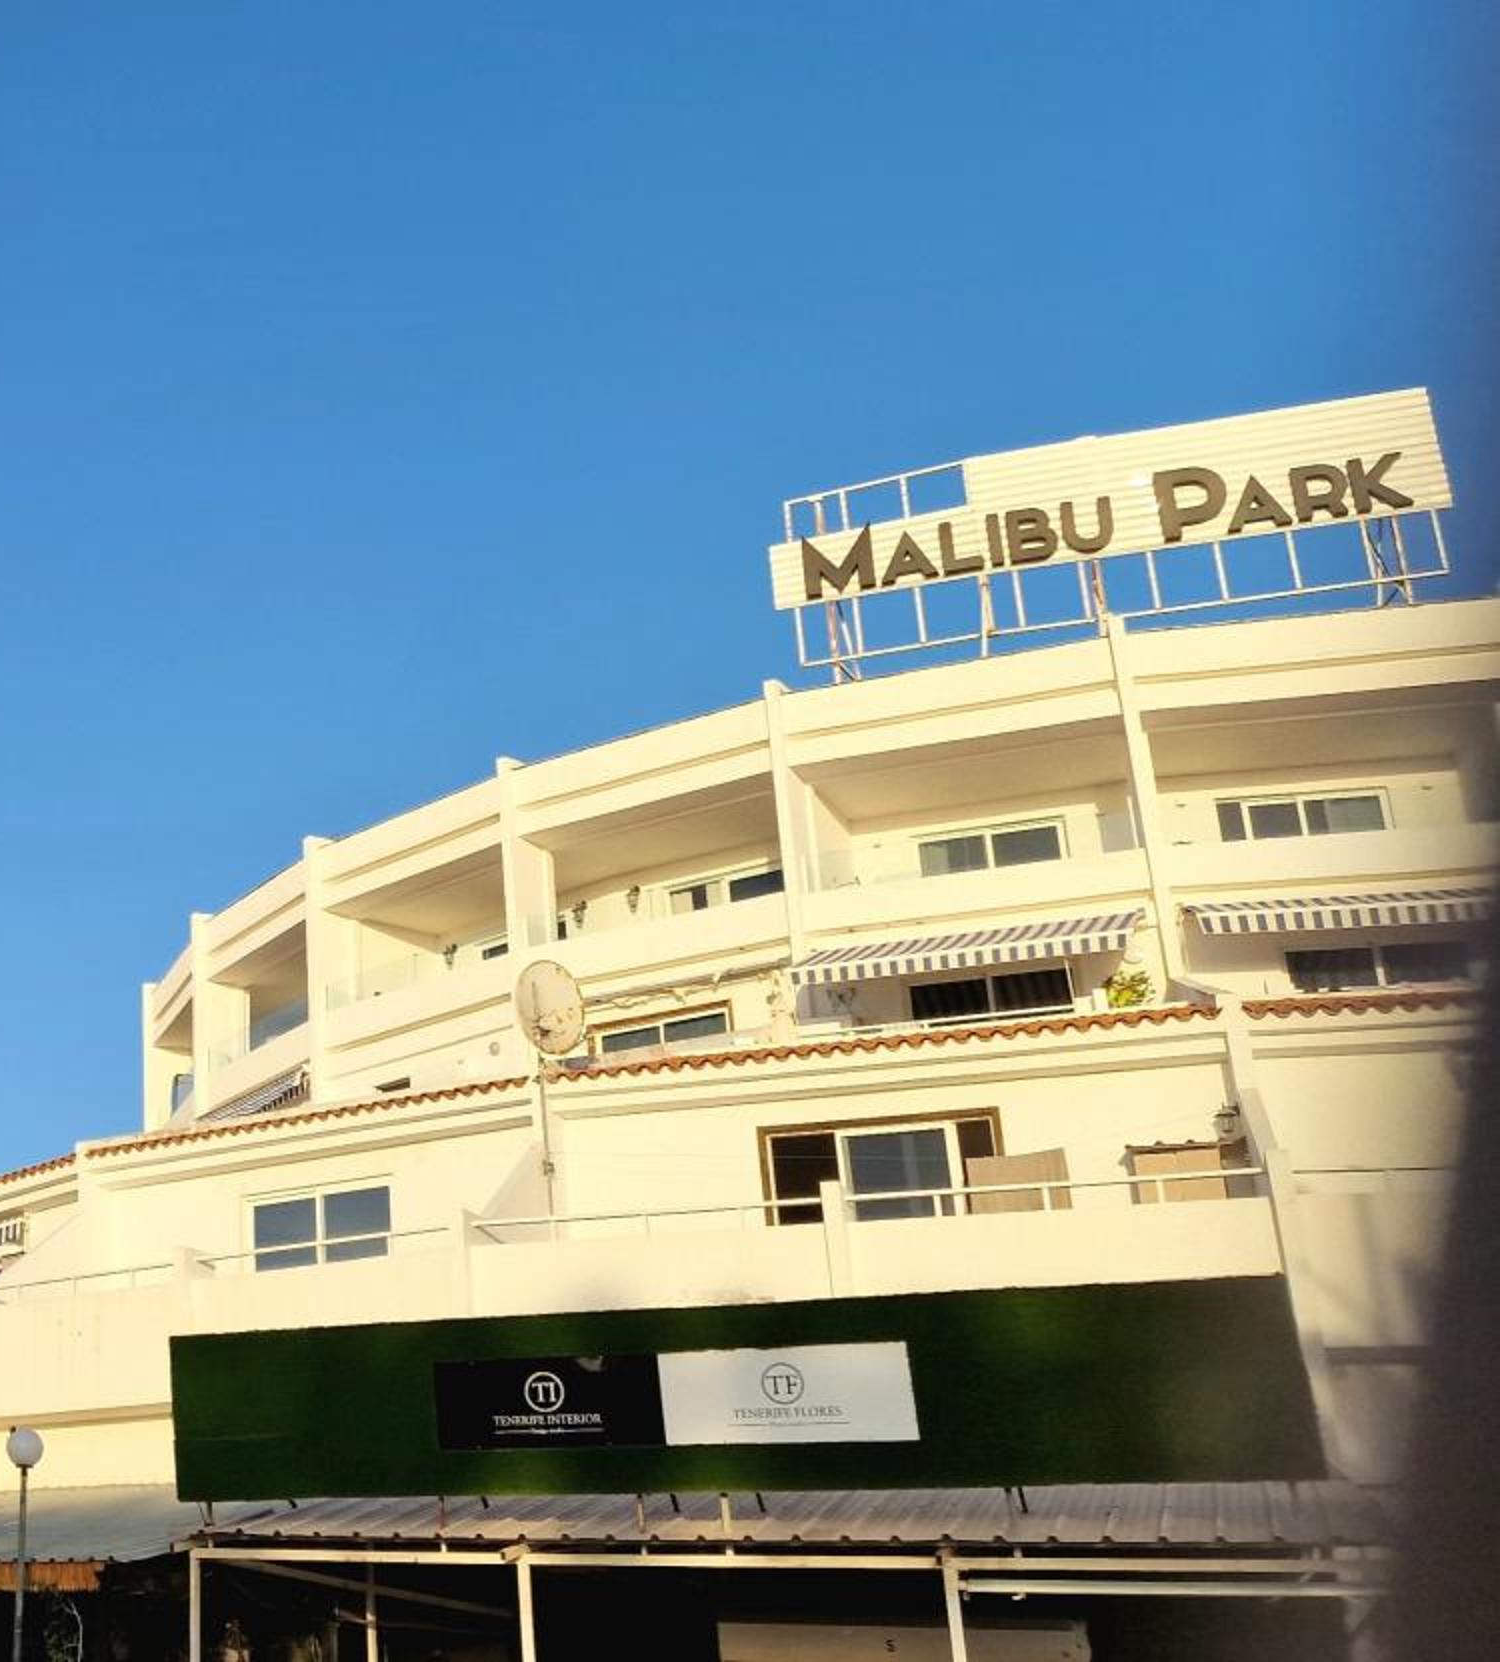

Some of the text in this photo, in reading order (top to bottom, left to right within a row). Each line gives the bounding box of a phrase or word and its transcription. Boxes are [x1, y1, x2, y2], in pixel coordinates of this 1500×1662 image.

[800, 451, 1414, 600] MALIBU PARK
[531, 1381, 557, 1403] TI
[764, 1375, 798, 1395] TF
[491, 1413, 603, 1427] TENERIFE INTERIOR
[732, 1405, 844, 1419] TENERIFE FLORES
